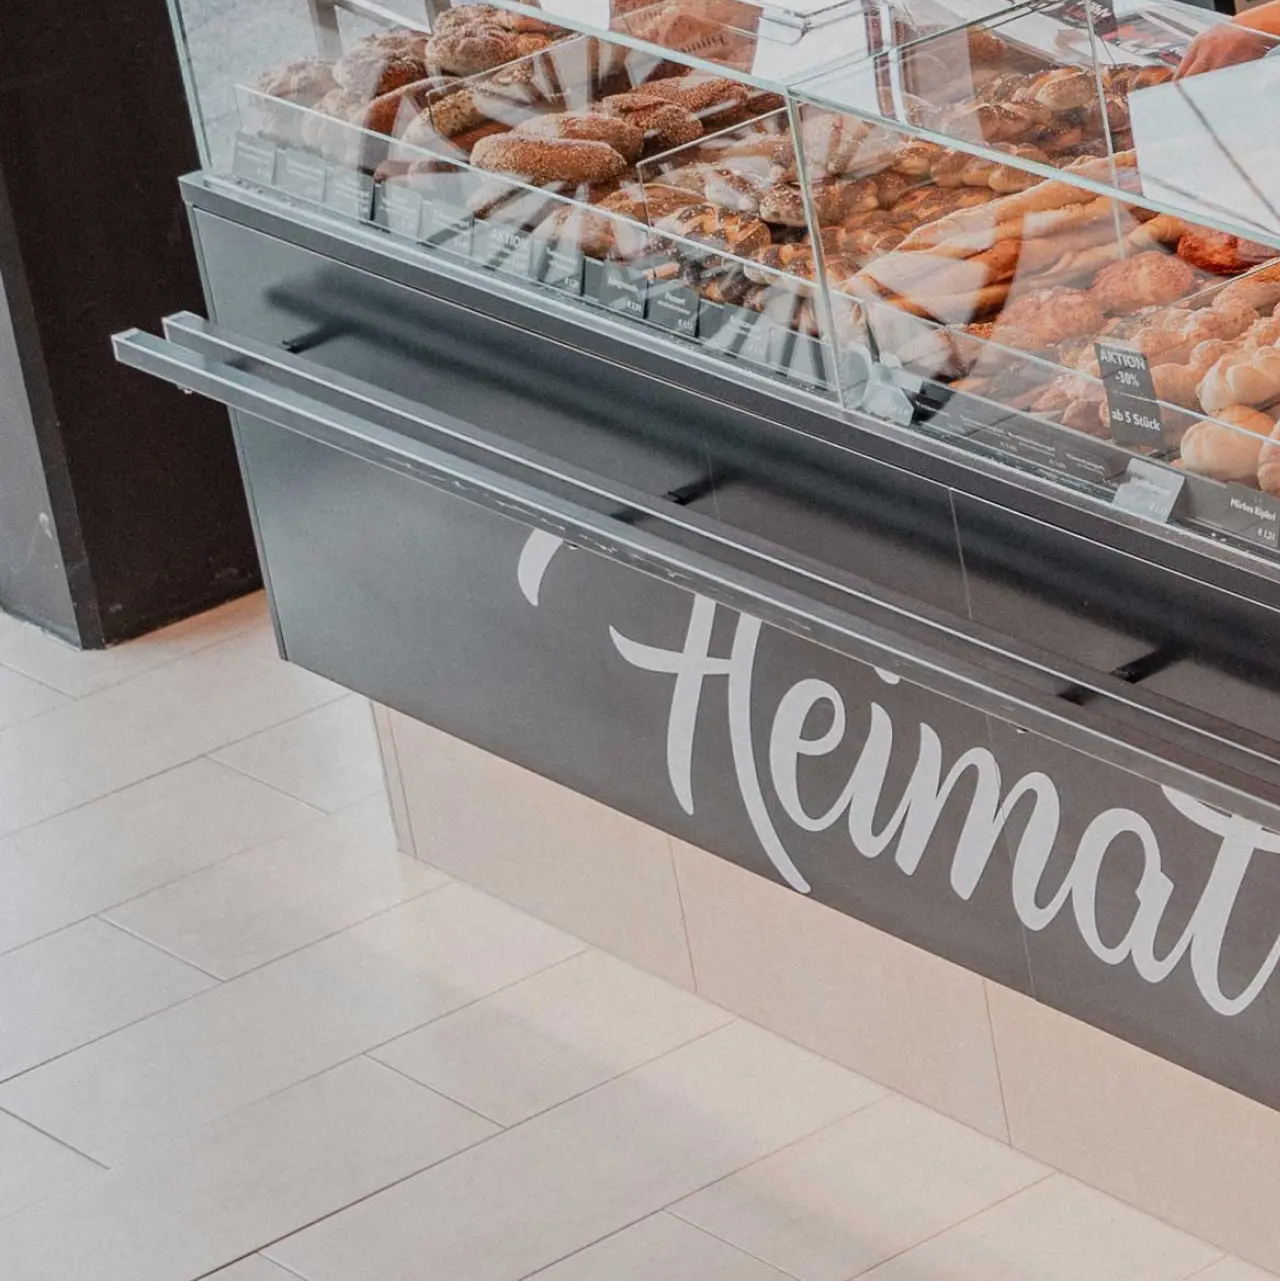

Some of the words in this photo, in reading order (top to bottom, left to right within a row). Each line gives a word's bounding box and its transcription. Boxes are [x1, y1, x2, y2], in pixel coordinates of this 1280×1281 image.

[1100, 349, 1146, 371] AKTION
[1115, 371, 1140, 387] -30%
[1111, 409, 1124, 422] ab
[1125, 411, 1131, 423] 5
[1133, 413, 1161, 431] Stück
